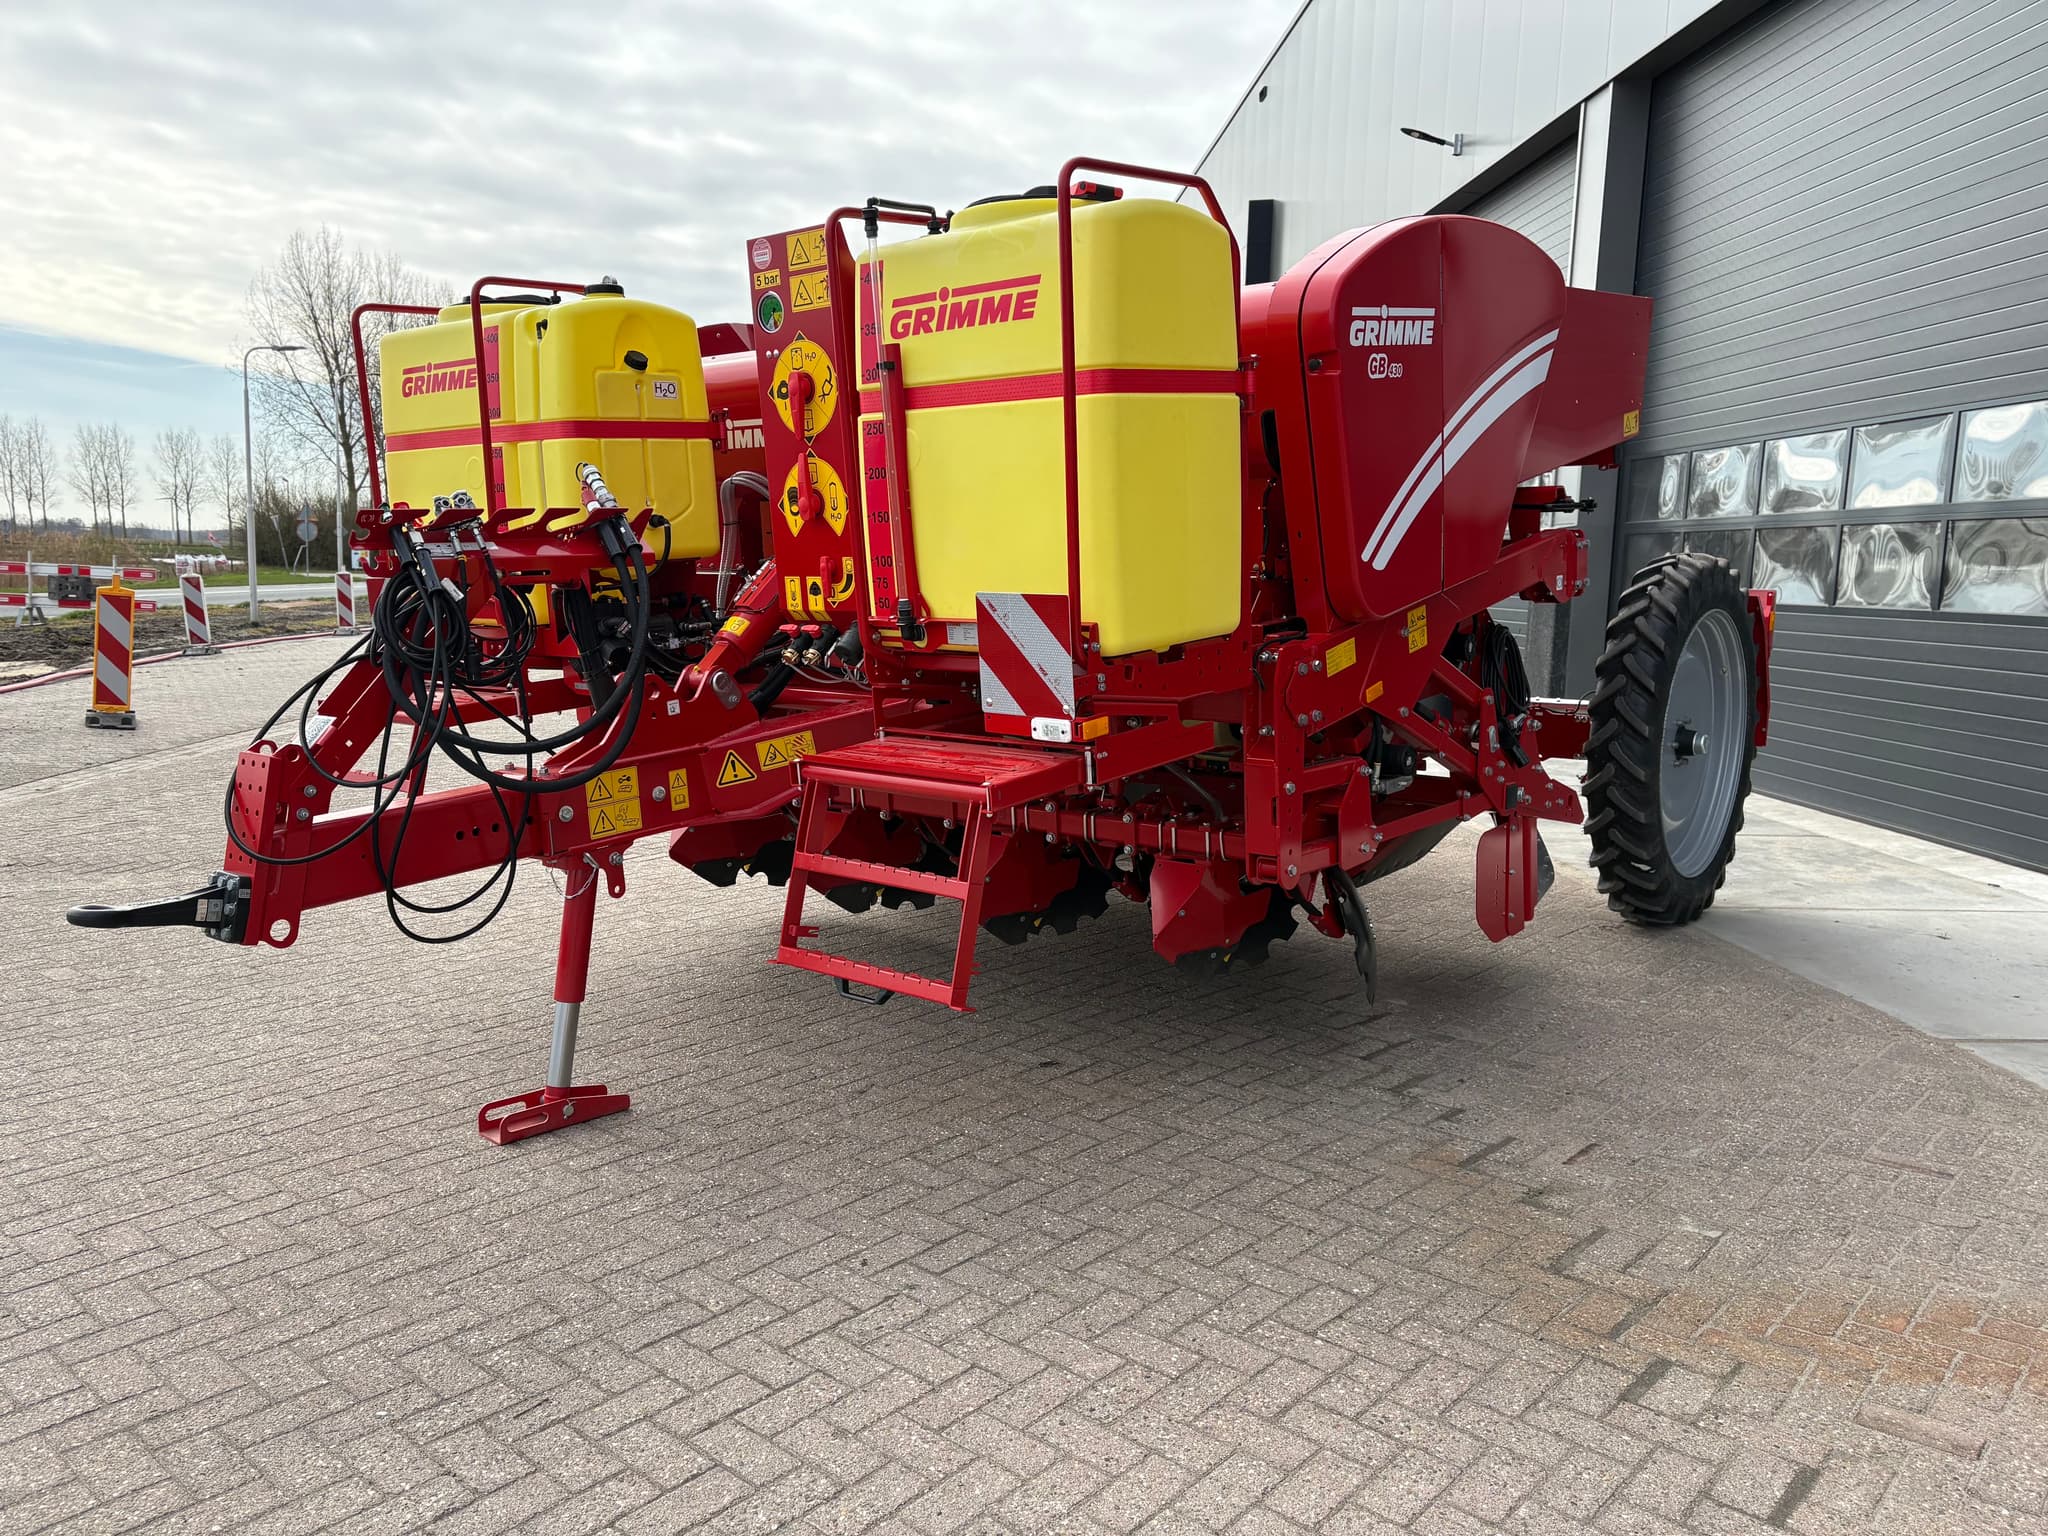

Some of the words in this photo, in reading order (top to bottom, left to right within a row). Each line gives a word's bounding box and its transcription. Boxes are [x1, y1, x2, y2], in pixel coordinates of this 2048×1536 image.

[756, 275, 763, 287] 5
[764, 272, 779, 285] bar
[889, 286, 1039, 340] GRIMME
[1349, 304, 1435, 347] GRIMME
[1368, 353, 1388, 379] GB
[1388, 363, 1404, 378] 430
[401, 362, 478, 398] GRIMME
[486, 373, 500, 385] 350
[654, 382, 676, 398] H2O
[866, 422, 885, 436] 250
[868, 468, 887, 480] 200
[494, 482, 505, 493] 00
[871, 511, 890, 523] 150
[874, 555, 893, 568] 100
[876, 577, 889, 590] 75
[878, 597, 890, 609] 50
